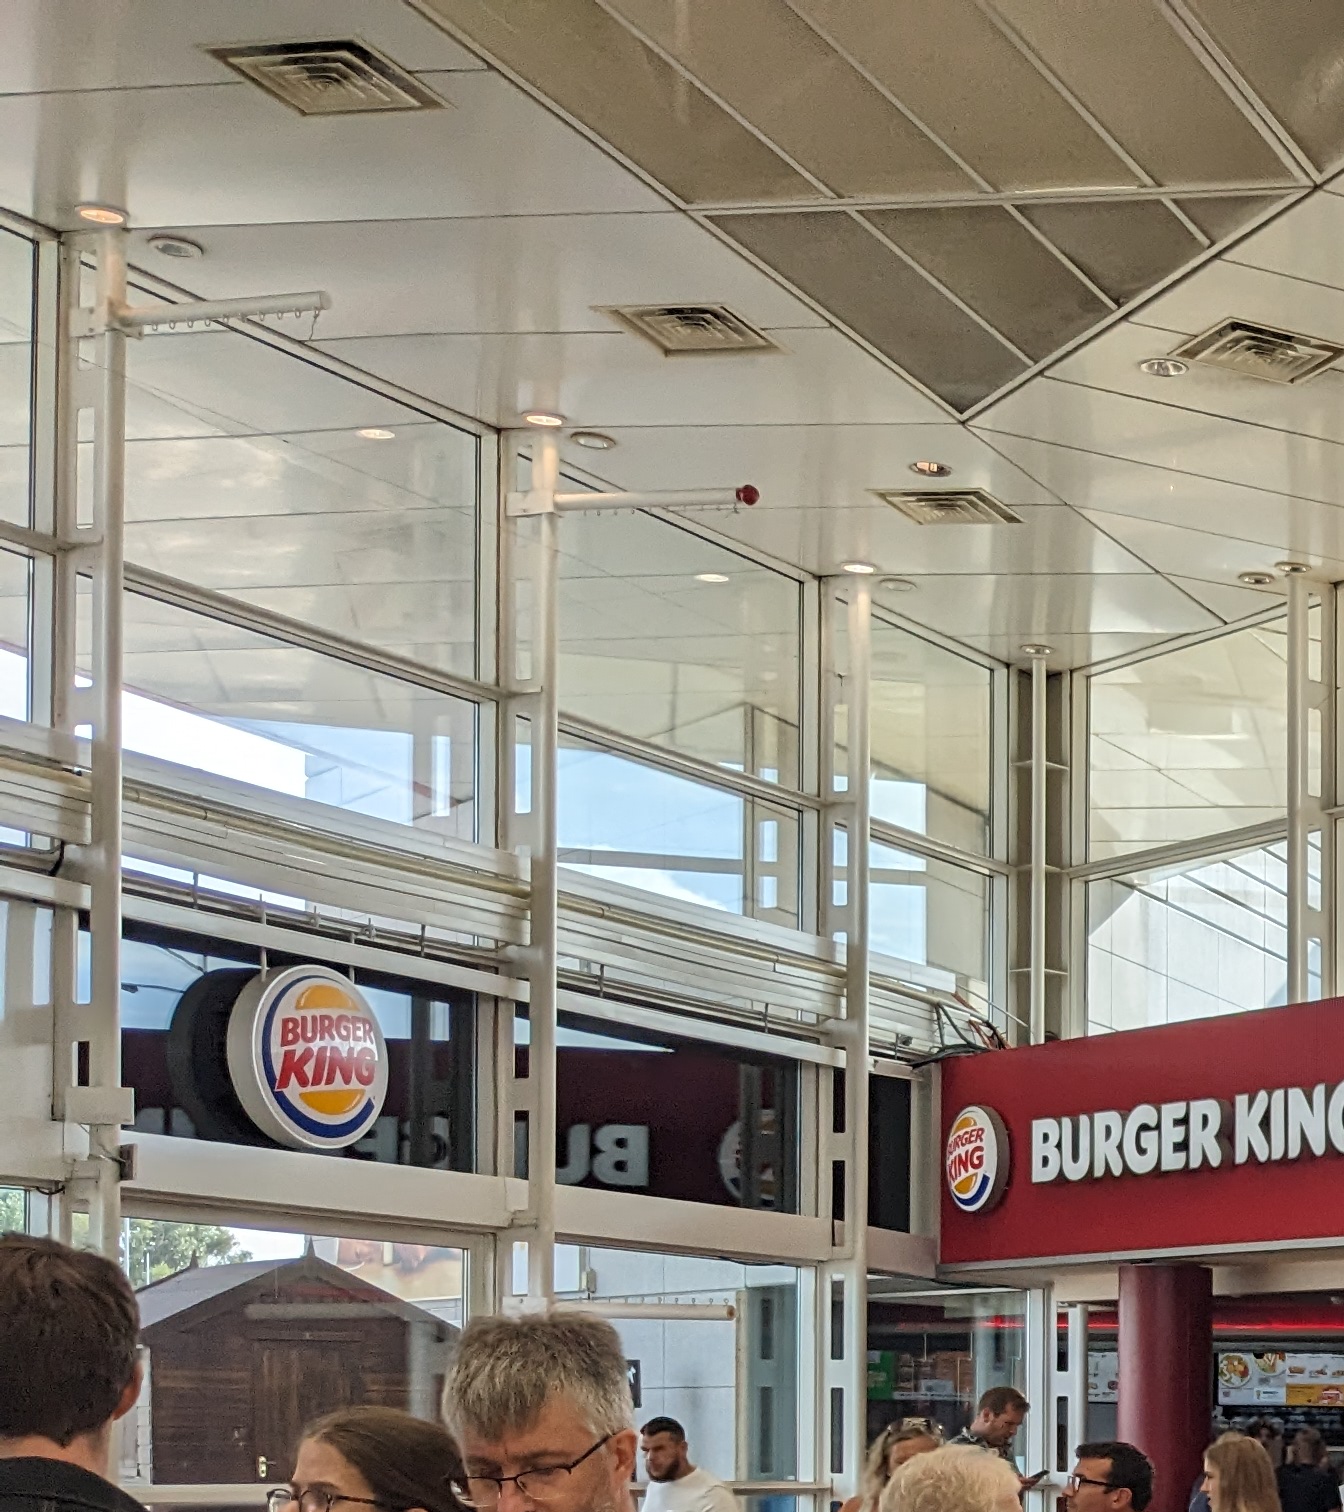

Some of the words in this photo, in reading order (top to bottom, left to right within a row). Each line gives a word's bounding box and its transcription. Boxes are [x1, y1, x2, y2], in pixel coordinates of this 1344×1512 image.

[280, 1014, 375, 1048] BURGER
[275, 1045, 376, 1090] KING
[948, 1127, 985, 1156] BURGER
[1031, 1098, 1222, 1184] BURGER
[948, 1145, 985, 1183] KING
